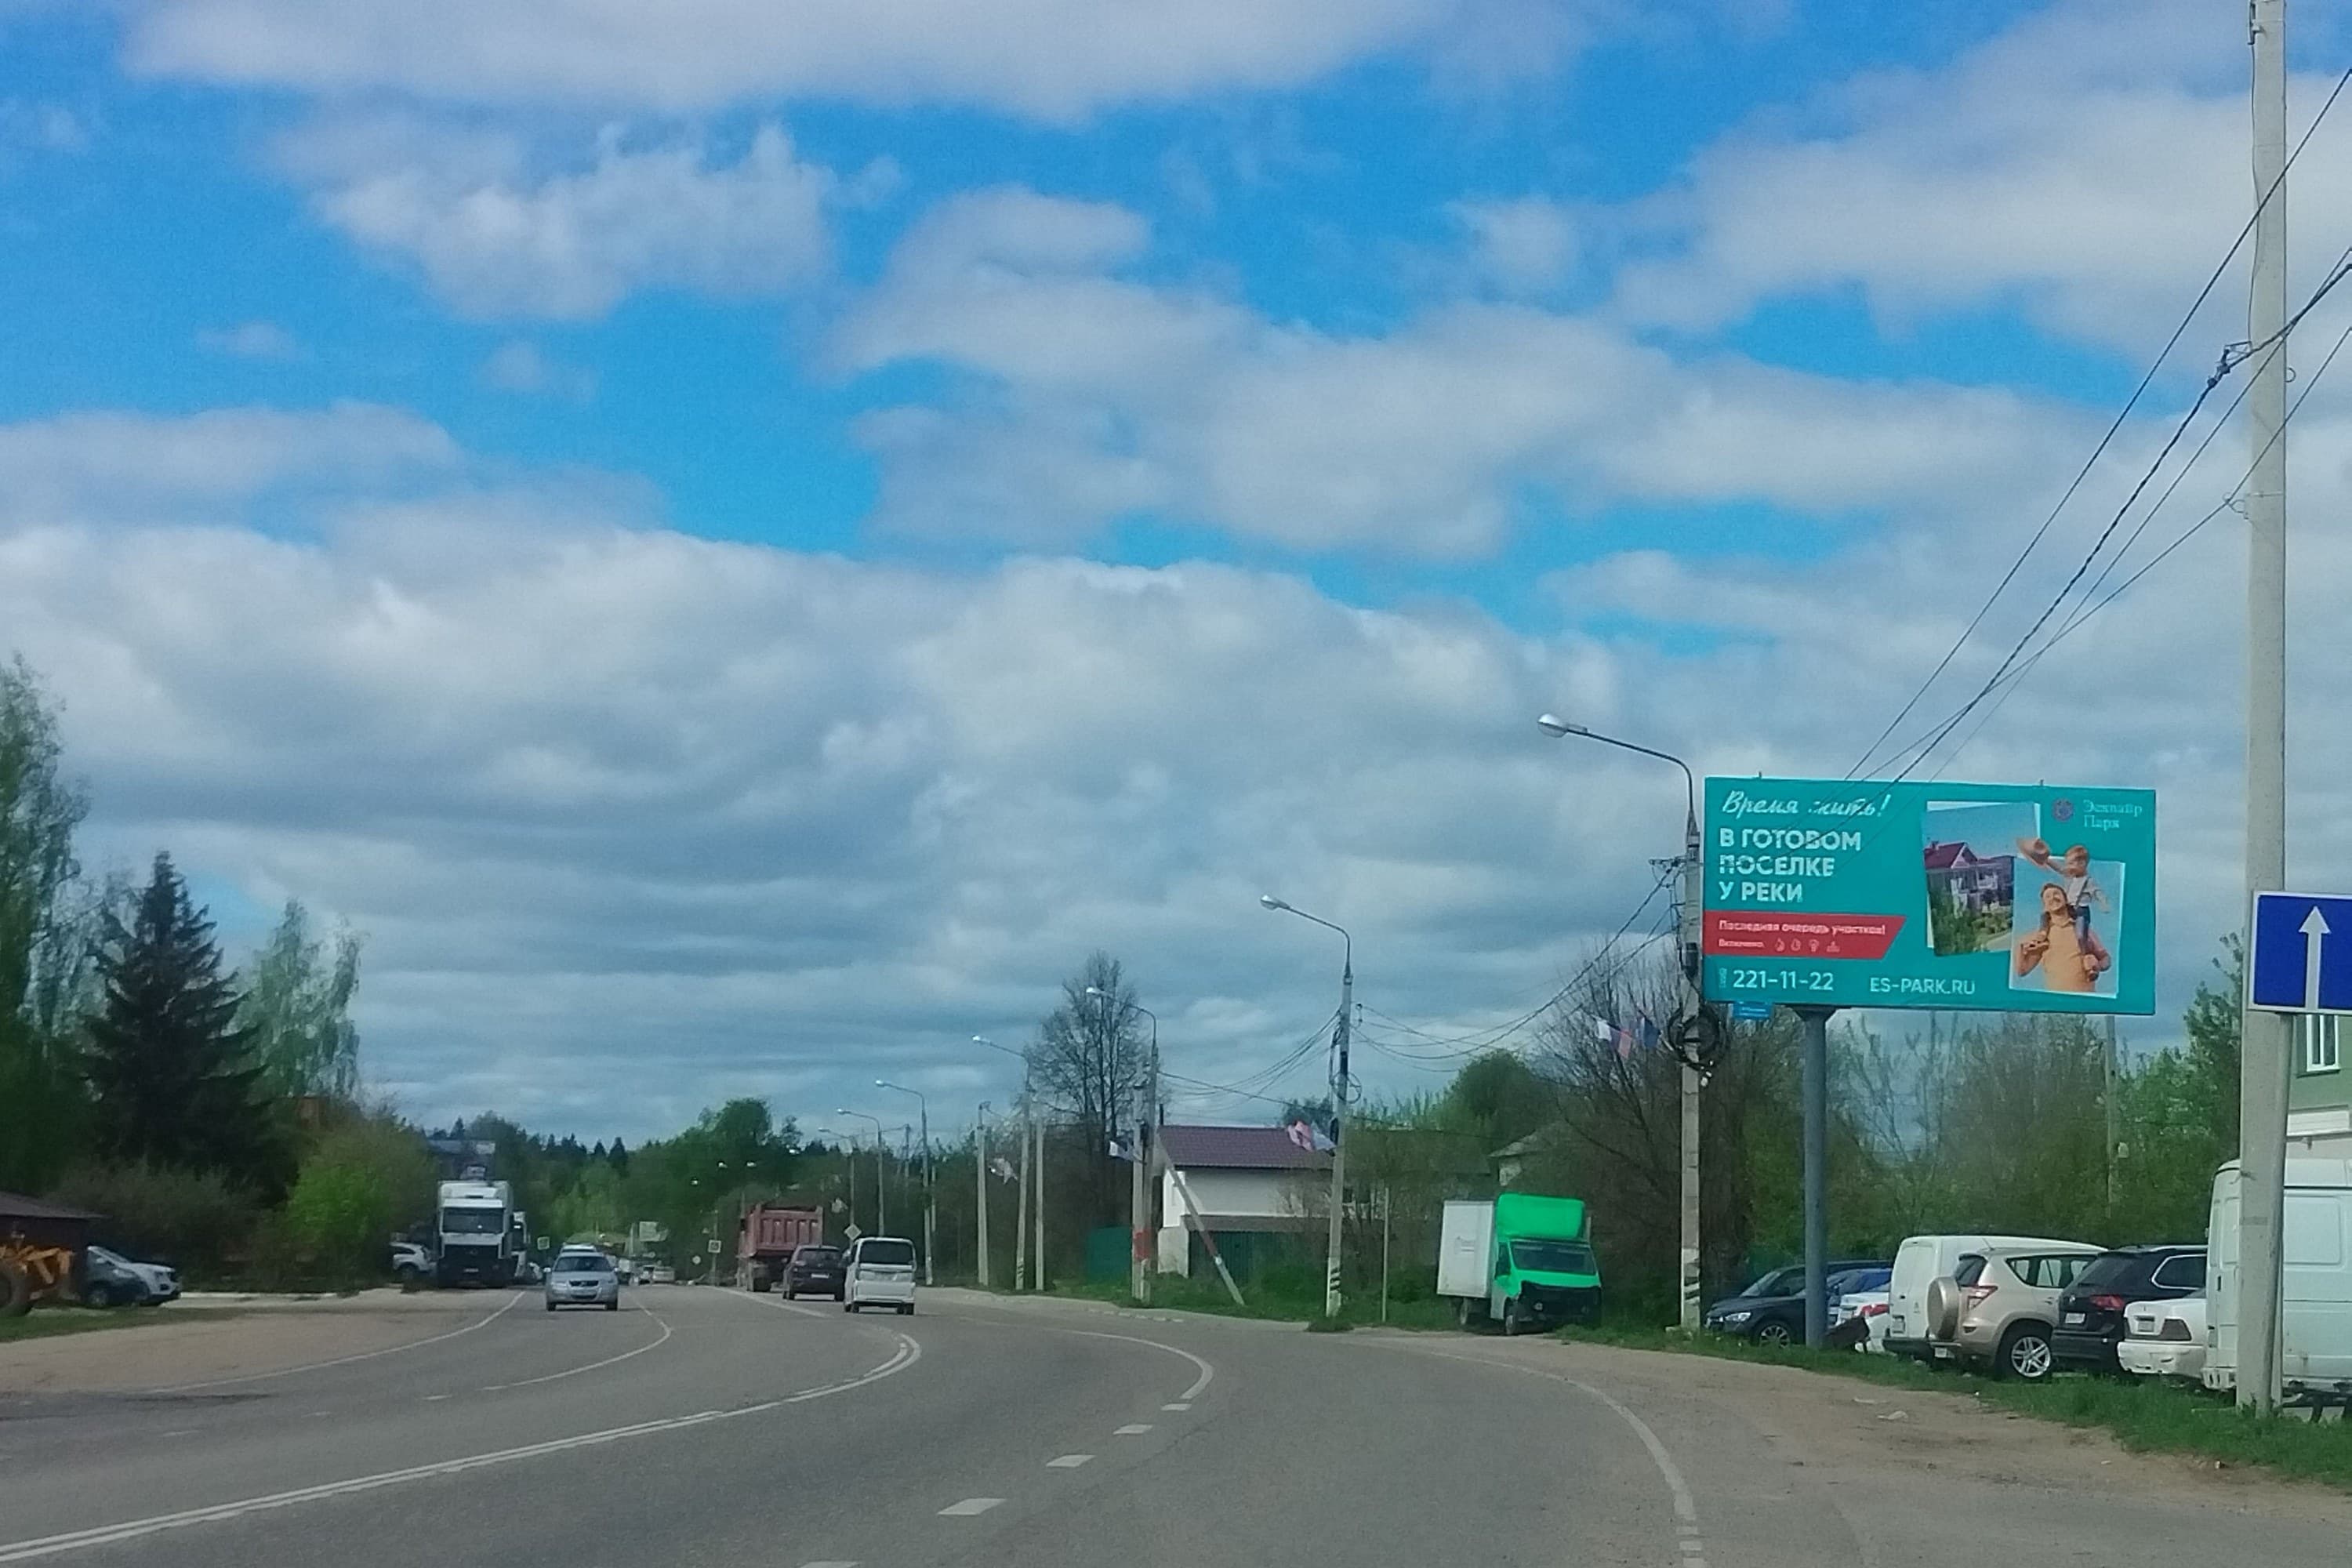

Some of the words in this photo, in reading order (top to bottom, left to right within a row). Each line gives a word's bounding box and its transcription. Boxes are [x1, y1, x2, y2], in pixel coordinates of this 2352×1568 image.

[1722, 790, 1798, 819] Время
[2083, 815, 2120, 831] Парк
[1720, 828, 1734, 848] В
[1741, 829, 1861, 851] ГОТОВОМ
[1719, 855, 1835, 877] ПОСЕЛКЕ
[1719, 881, 1734, 900] У
[1741, 882, 1802, 902] РЕКИ
[1733, 969, 1835, 991] 221-11-22
[1870, 977, 1976, 995] ES-PARK.RU
